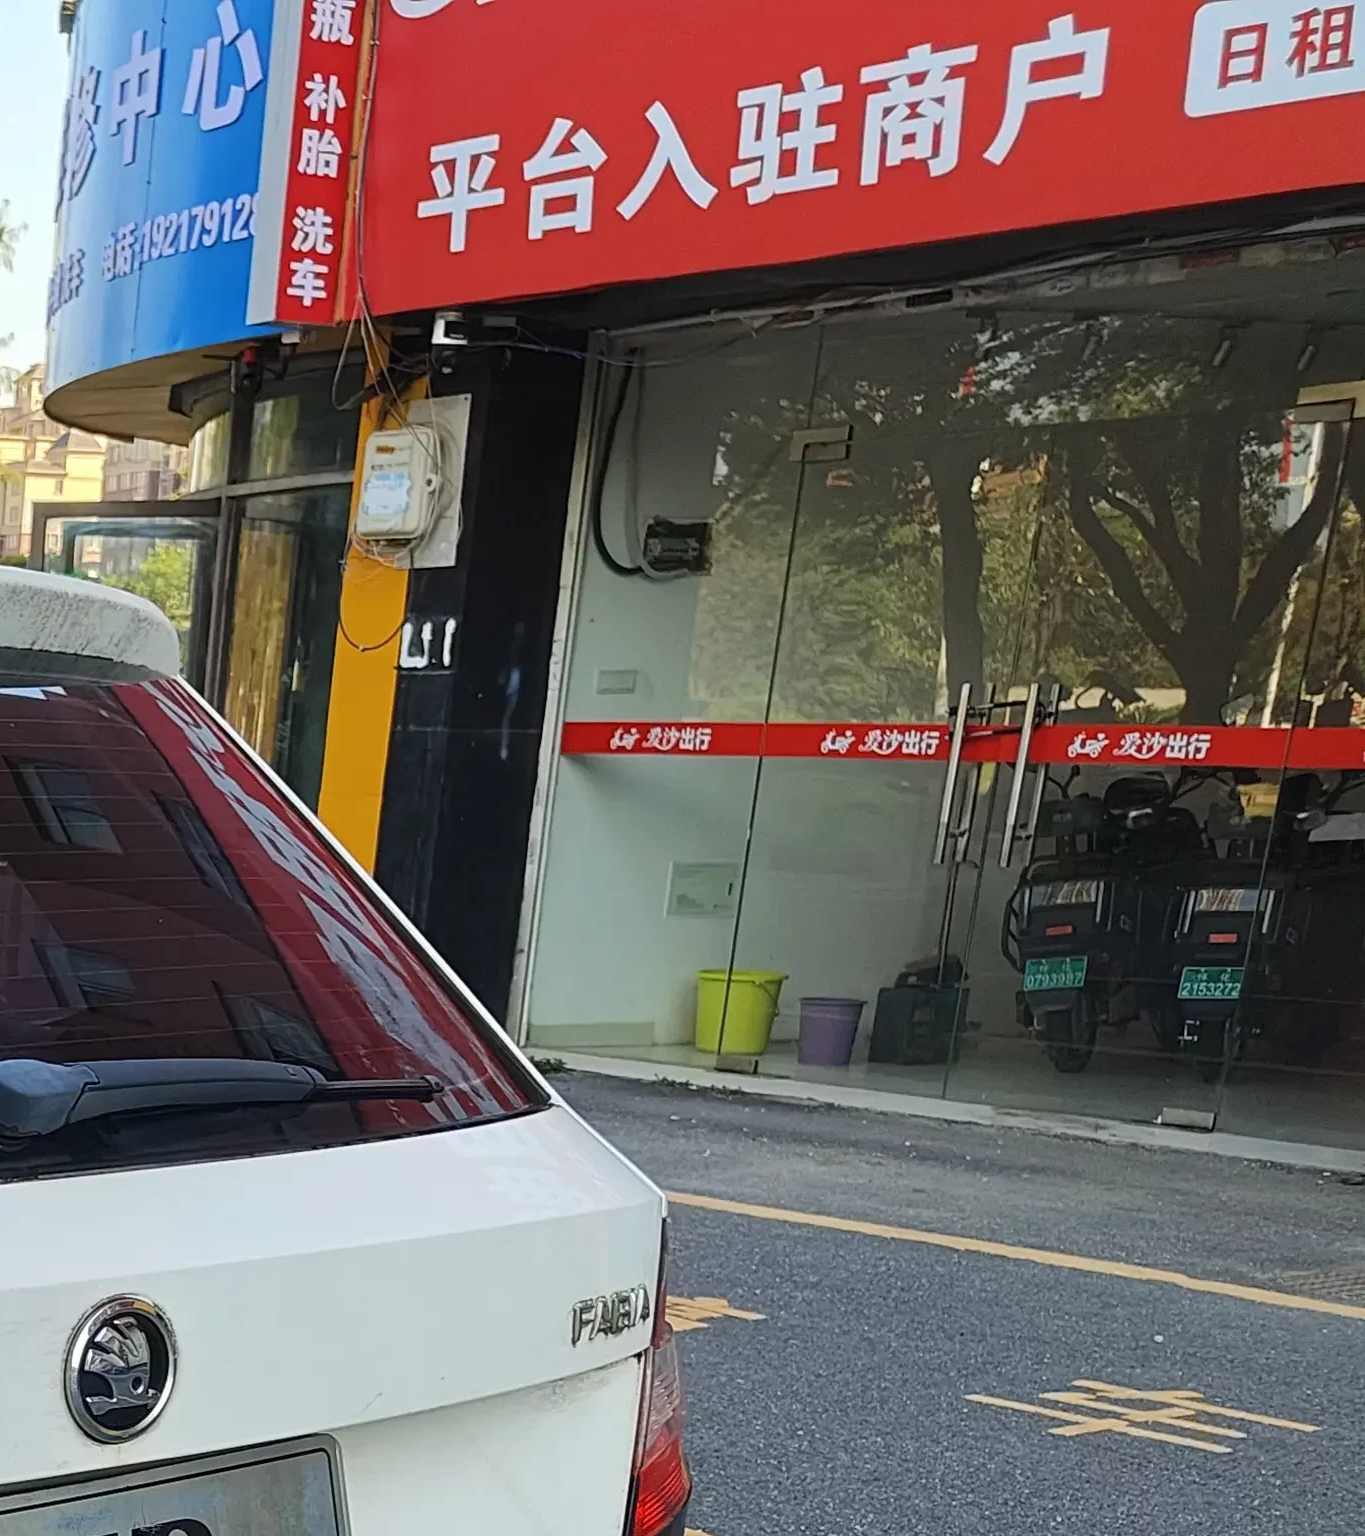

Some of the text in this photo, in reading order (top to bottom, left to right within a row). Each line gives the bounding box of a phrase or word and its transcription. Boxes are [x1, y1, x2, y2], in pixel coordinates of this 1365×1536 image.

[1217, 4, 1355, 90] 日租
[297, 73, 347, 179] 补胎
[417, 14, 1111, 253] 平台入驻商户
[286, 205, 334, 307] 洗车
[1113, 731, 1212, 760] 爱沙出行
[1181, 982, 1241, 997] 2153272
